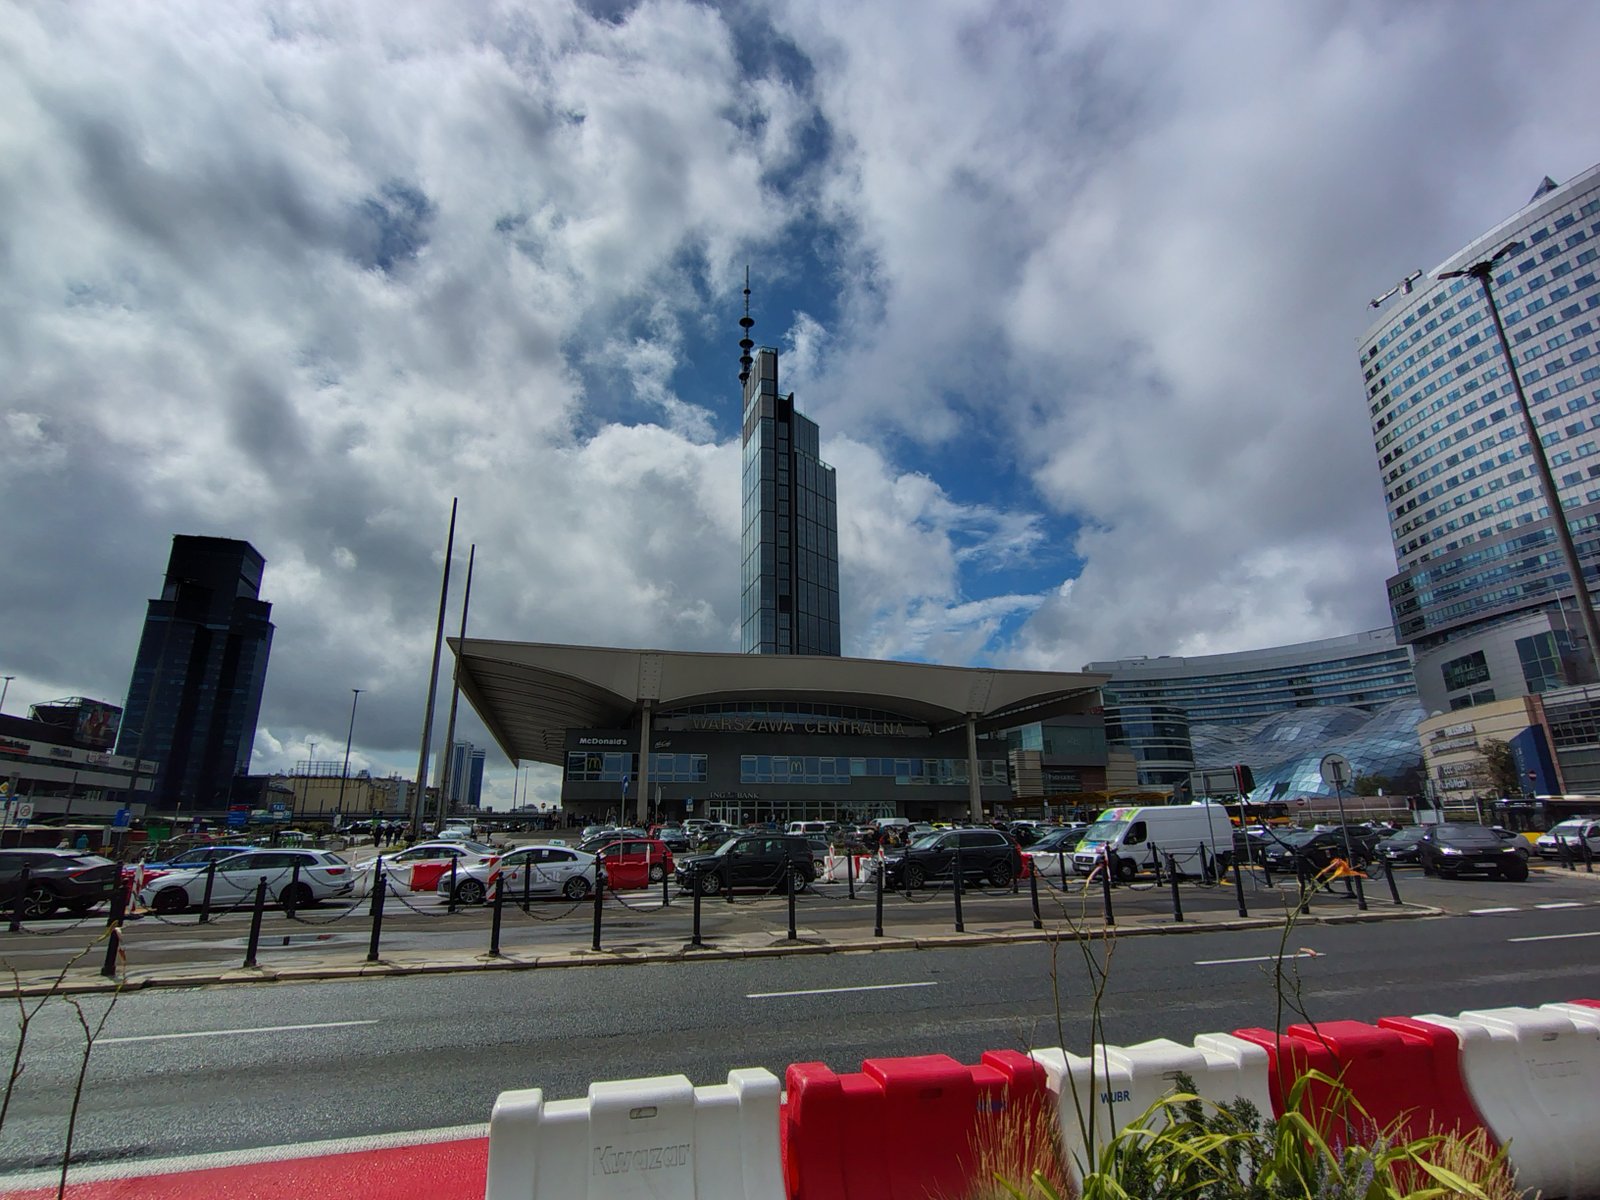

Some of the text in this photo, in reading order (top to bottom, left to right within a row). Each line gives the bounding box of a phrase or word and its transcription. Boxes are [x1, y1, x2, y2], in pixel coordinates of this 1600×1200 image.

[692, 717, 906, 735] WARSZAWA CENTRALNA
[579, 737, 628, 746] McDonald's
[536, 870, 561, 883] Bolt
[1100, 1090, 1131, 1105] WUBR
[592, 1144, 690, 1176] Kwazar
